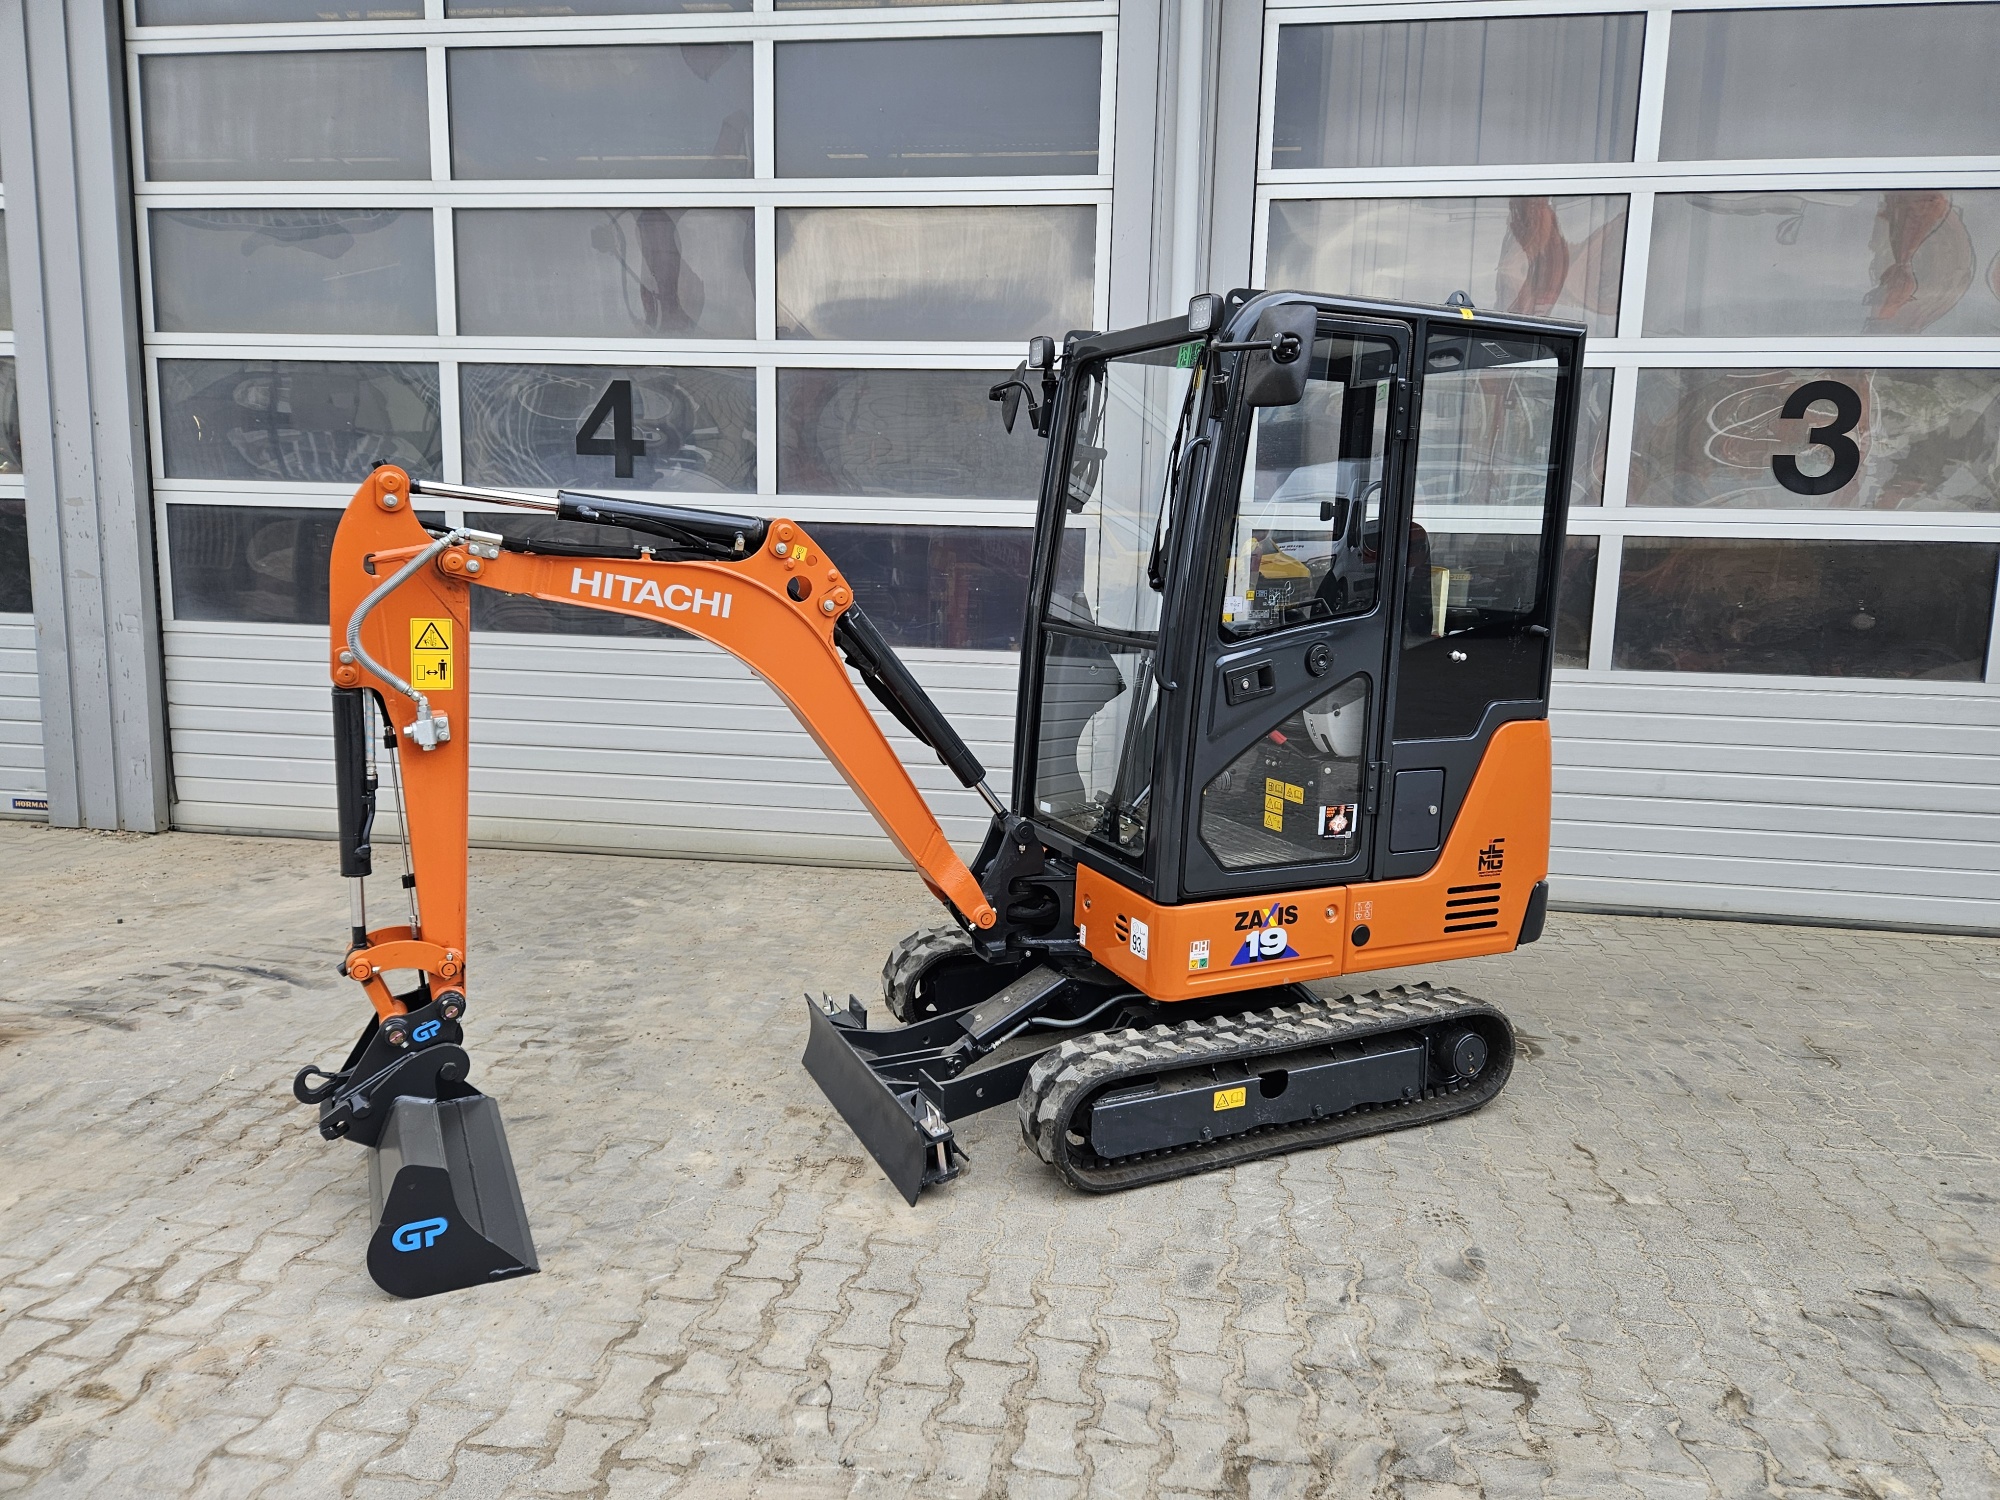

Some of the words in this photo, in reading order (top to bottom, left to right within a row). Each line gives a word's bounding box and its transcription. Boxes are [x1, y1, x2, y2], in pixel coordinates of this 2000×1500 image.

[576, 380, 645, 478] 4
[1773, 380, 1861, 495] 3
[570, 568, 732, 618] HITACHI
[1234, 903, 1298, 931] ZAXIS
[1132, 934, 1142, 953] 93
[1246, 927, 1288, 961] 19
[412, 1019, 441, 1042] GP
[392, 1217, 448, 1252] GP
